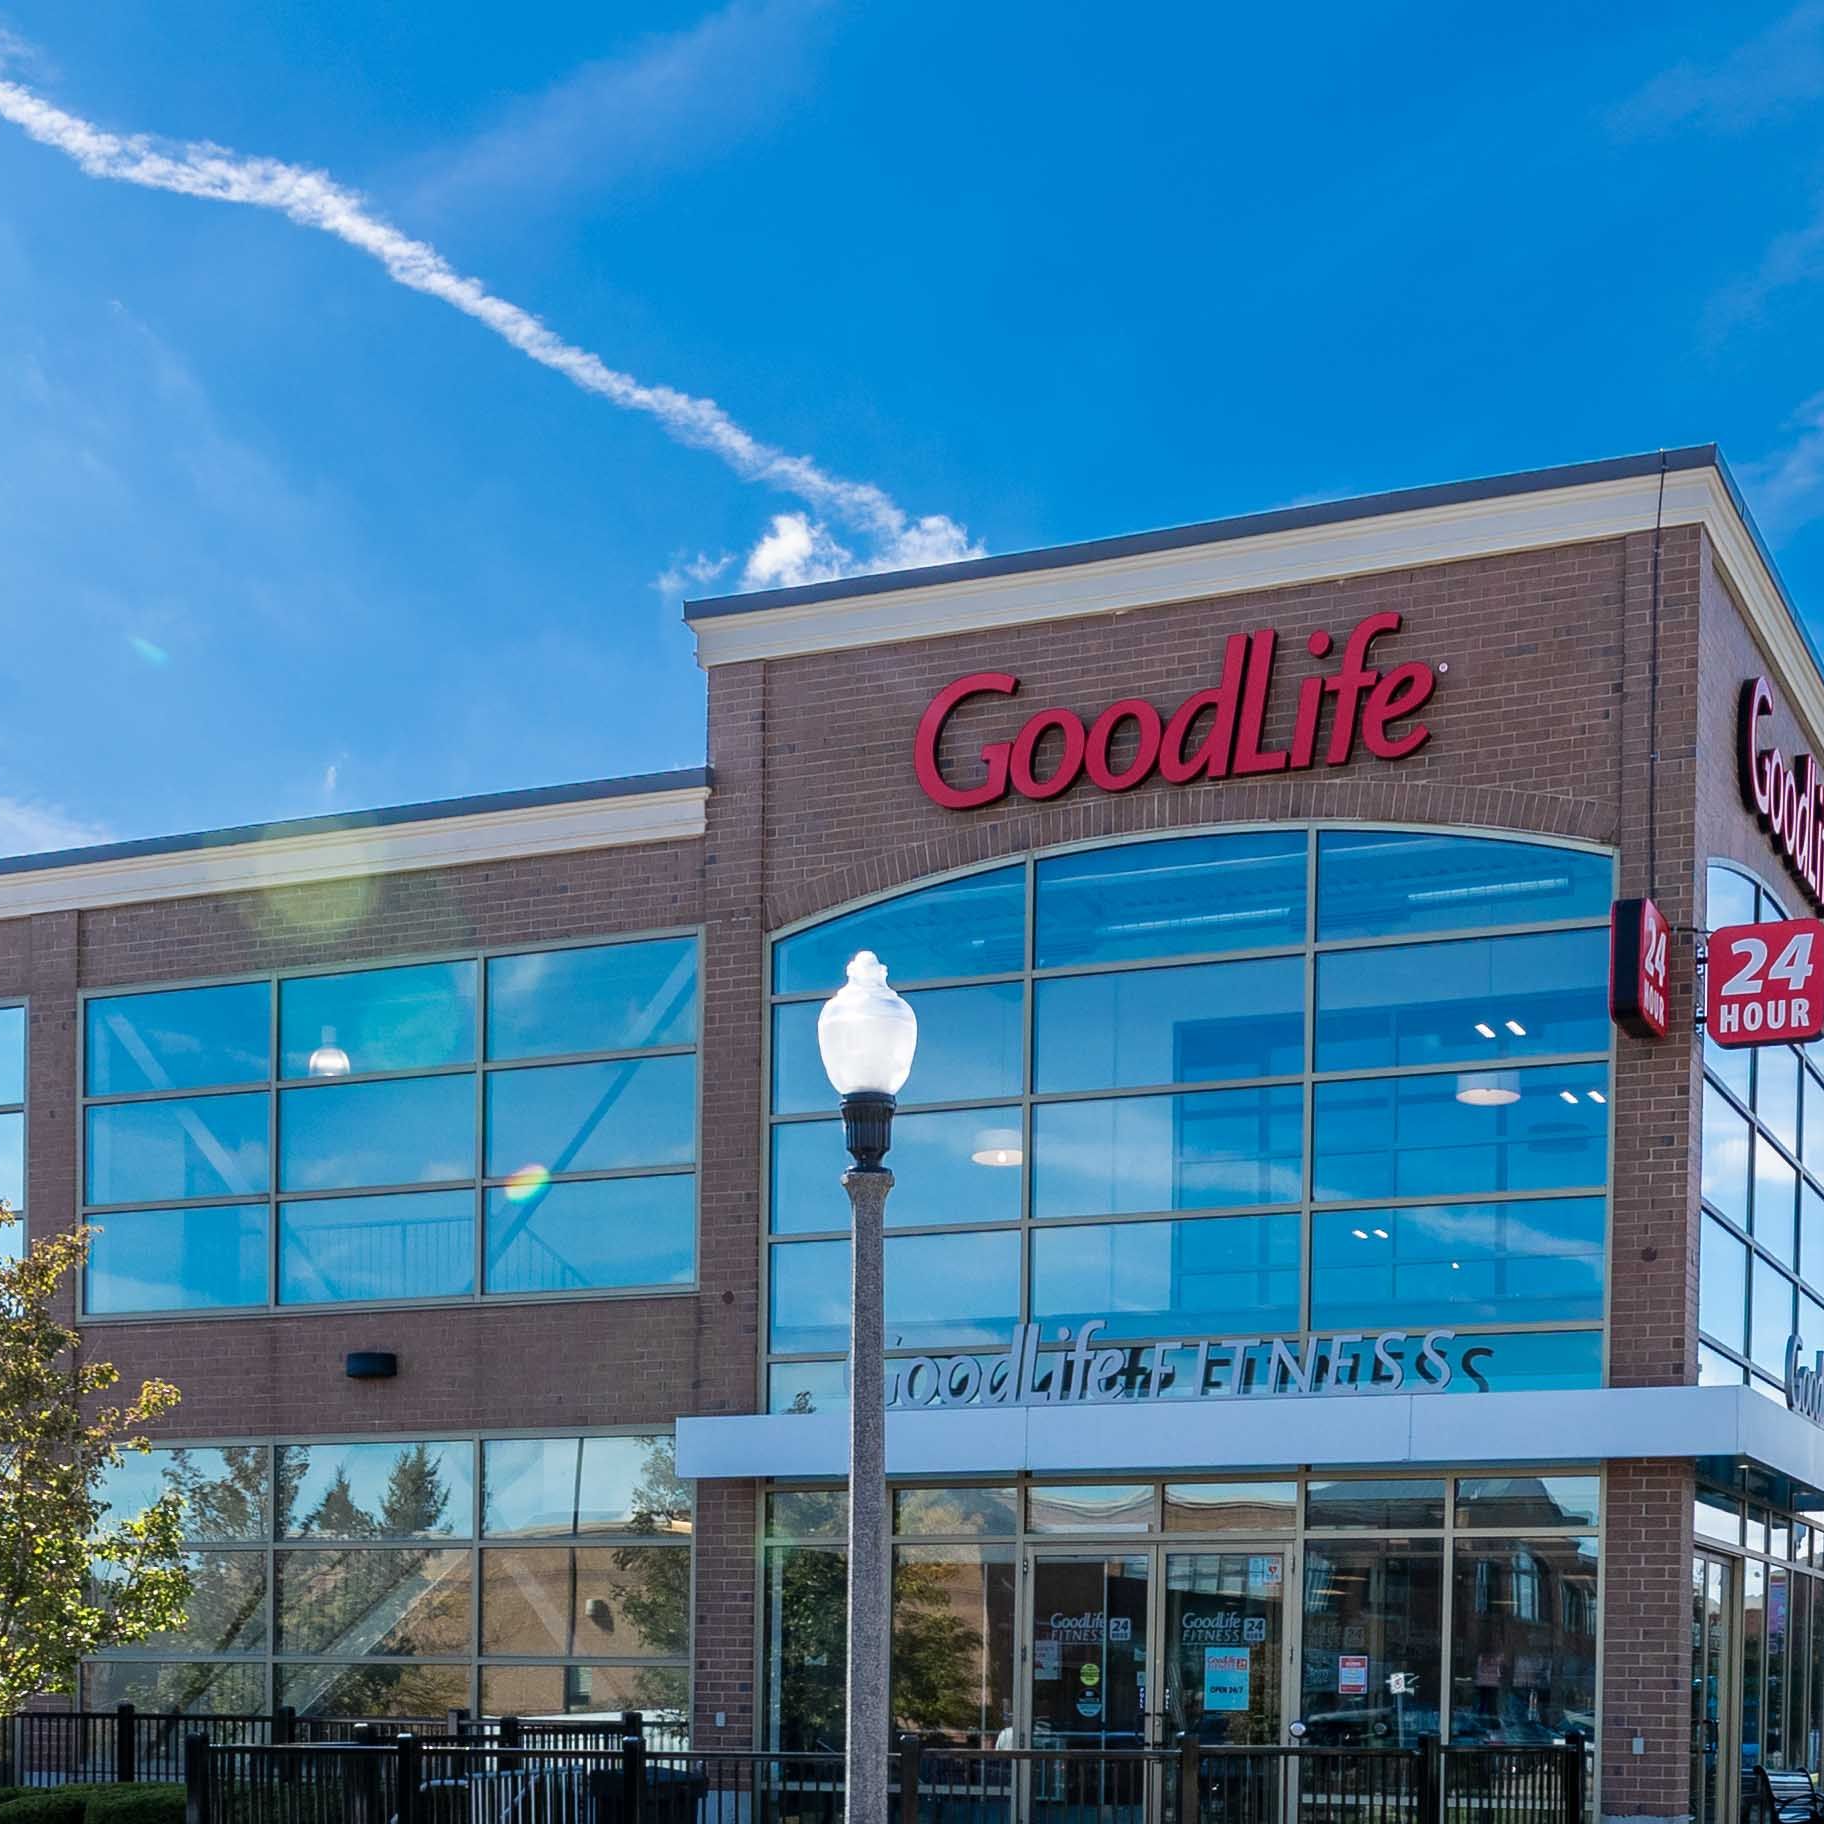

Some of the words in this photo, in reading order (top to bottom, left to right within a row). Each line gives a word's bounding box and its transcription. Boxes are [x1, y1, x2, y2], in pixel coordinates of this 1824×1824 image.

[914, 612, 1437, 810] GoodLife
[1644, 917, 1668, 988] 24
[1720, 932, 1815, 996] 24
[1643, 977, 1665, 1028] HOUR
[1719, 998, 1810, 1034] HOUR
[1147, 1328, 1456, 1398] FITNESS
[1110, 1620, 1129, 1633] 24
[1182, 1611, 1241, 1630] GoodLife
[1182, 1629, 1241, 1642] FITNESS
[1246, 1620, 1264, 1632] 24
